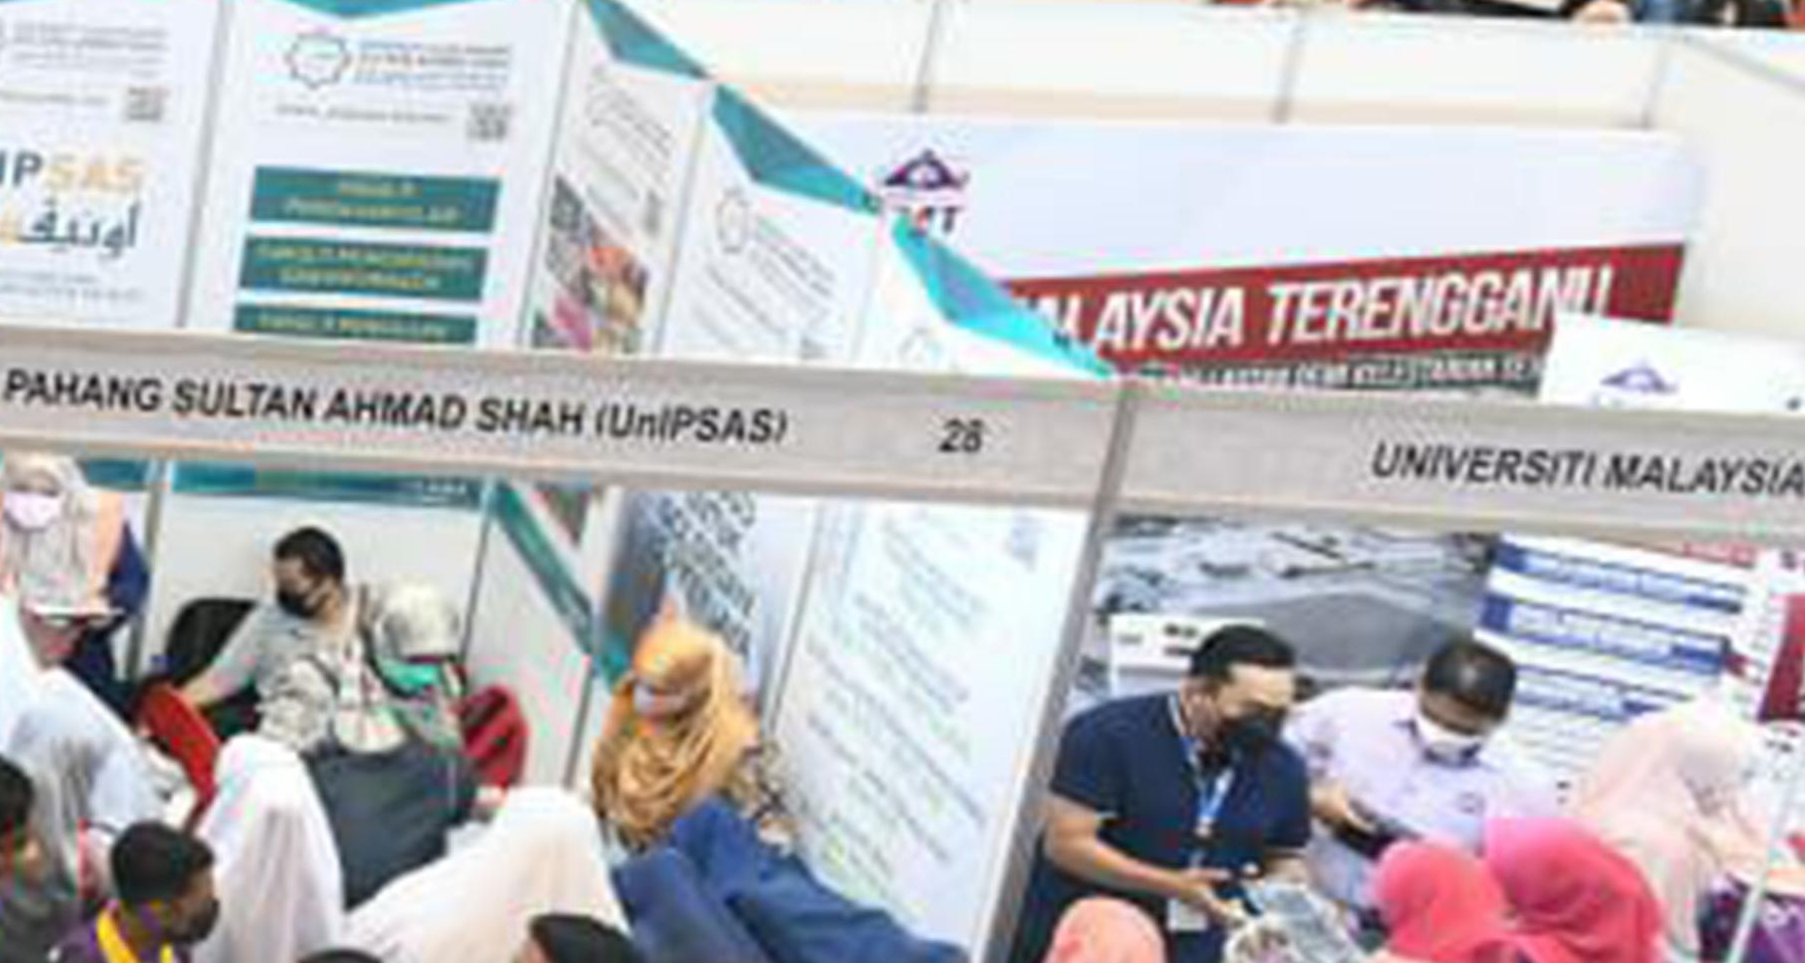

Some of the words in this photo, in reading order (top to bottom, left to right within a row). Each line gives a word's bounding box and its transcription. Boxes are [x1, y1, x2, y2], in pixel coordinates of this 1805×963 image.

[1266, 264, 1614, 347] TERENGGANU
[2, 369, 163, 413] PAHANG
[172, 377, 318, 422] SULTAN
[323, 386, 469, 430] AHMAD
[475, 394, 585, 437] SHAH
[595, 401, 789, 445] (UnIPSAS)
[937, 418, 987, 454] 28
[1370, 441, 1597, 488] UNIVERSITI
[1603, 452, 1805, 498] MALAYSIA
